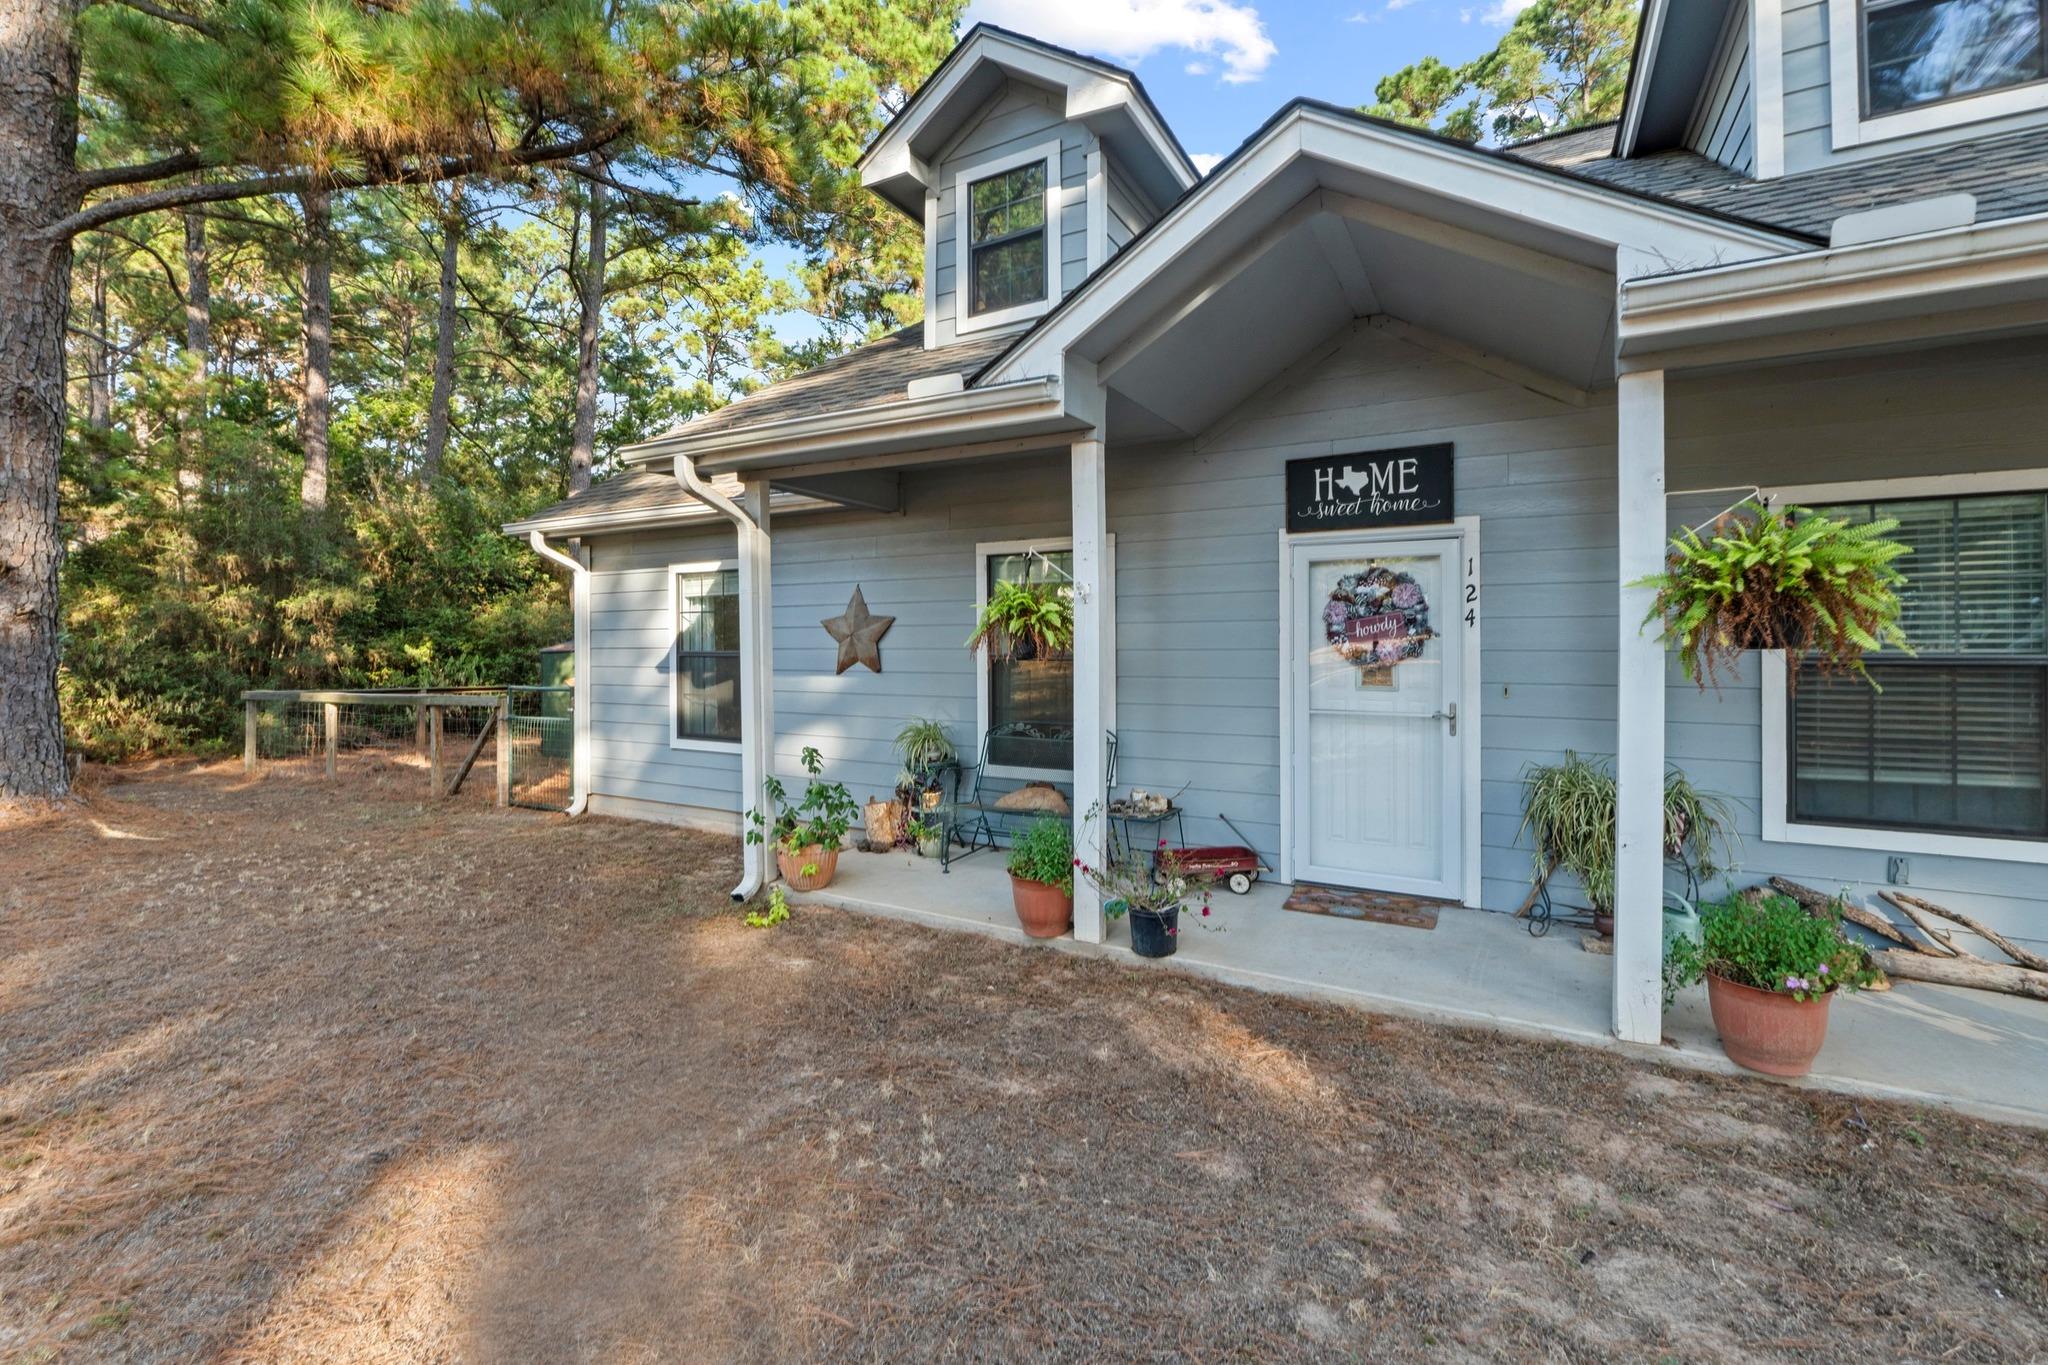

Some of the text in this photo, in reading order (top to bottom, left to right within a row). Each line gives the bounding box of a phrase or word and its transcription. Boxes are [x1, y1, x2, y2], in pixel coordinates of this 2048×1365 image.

[1314, 458, 1419, 502] HME
[1303, 491, 1433, 519] sweet home
[1464, 556, 1478, 628] 124
[1354, 616, 1398, 638] howdy
